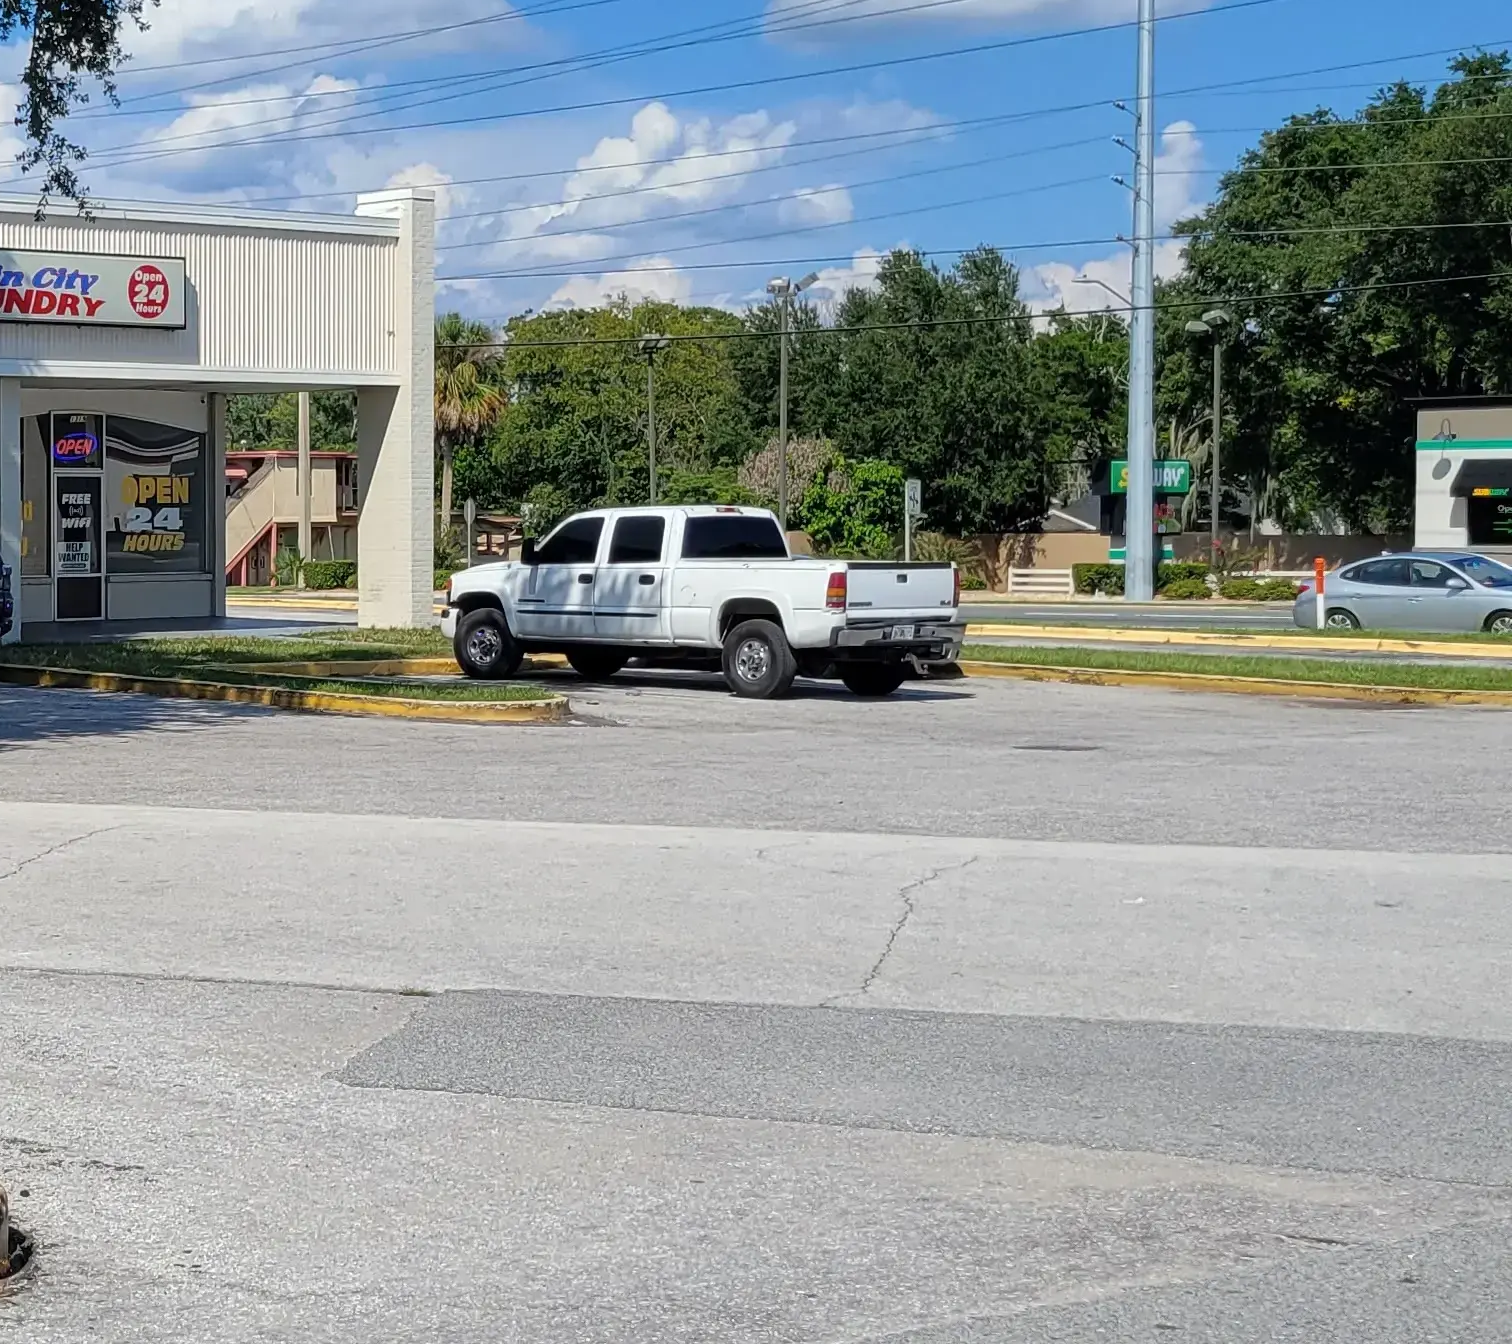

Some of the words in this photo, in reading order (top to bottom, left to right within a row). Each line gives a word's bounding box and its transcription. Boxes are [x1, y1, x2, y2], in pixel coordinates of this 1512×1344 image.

[32, 267, 99, 296] City
[134, 270, 163, 284] Open
[133, 284, 165, 303] 24
[136, 303, 162, 313] Hours
[56, 438, 93, 456] OPEN
[1117, 467, 1185, 488] SWAY
[61, 493, 92, 505] FREE
[121, 476, 190, 504] OPEN
[126, 506, 184, 532] 24
[65, 542, 84, 553] HELP
[122, 532, 185, 552] HOURS
[58, 552, 90, 563] WANTED
